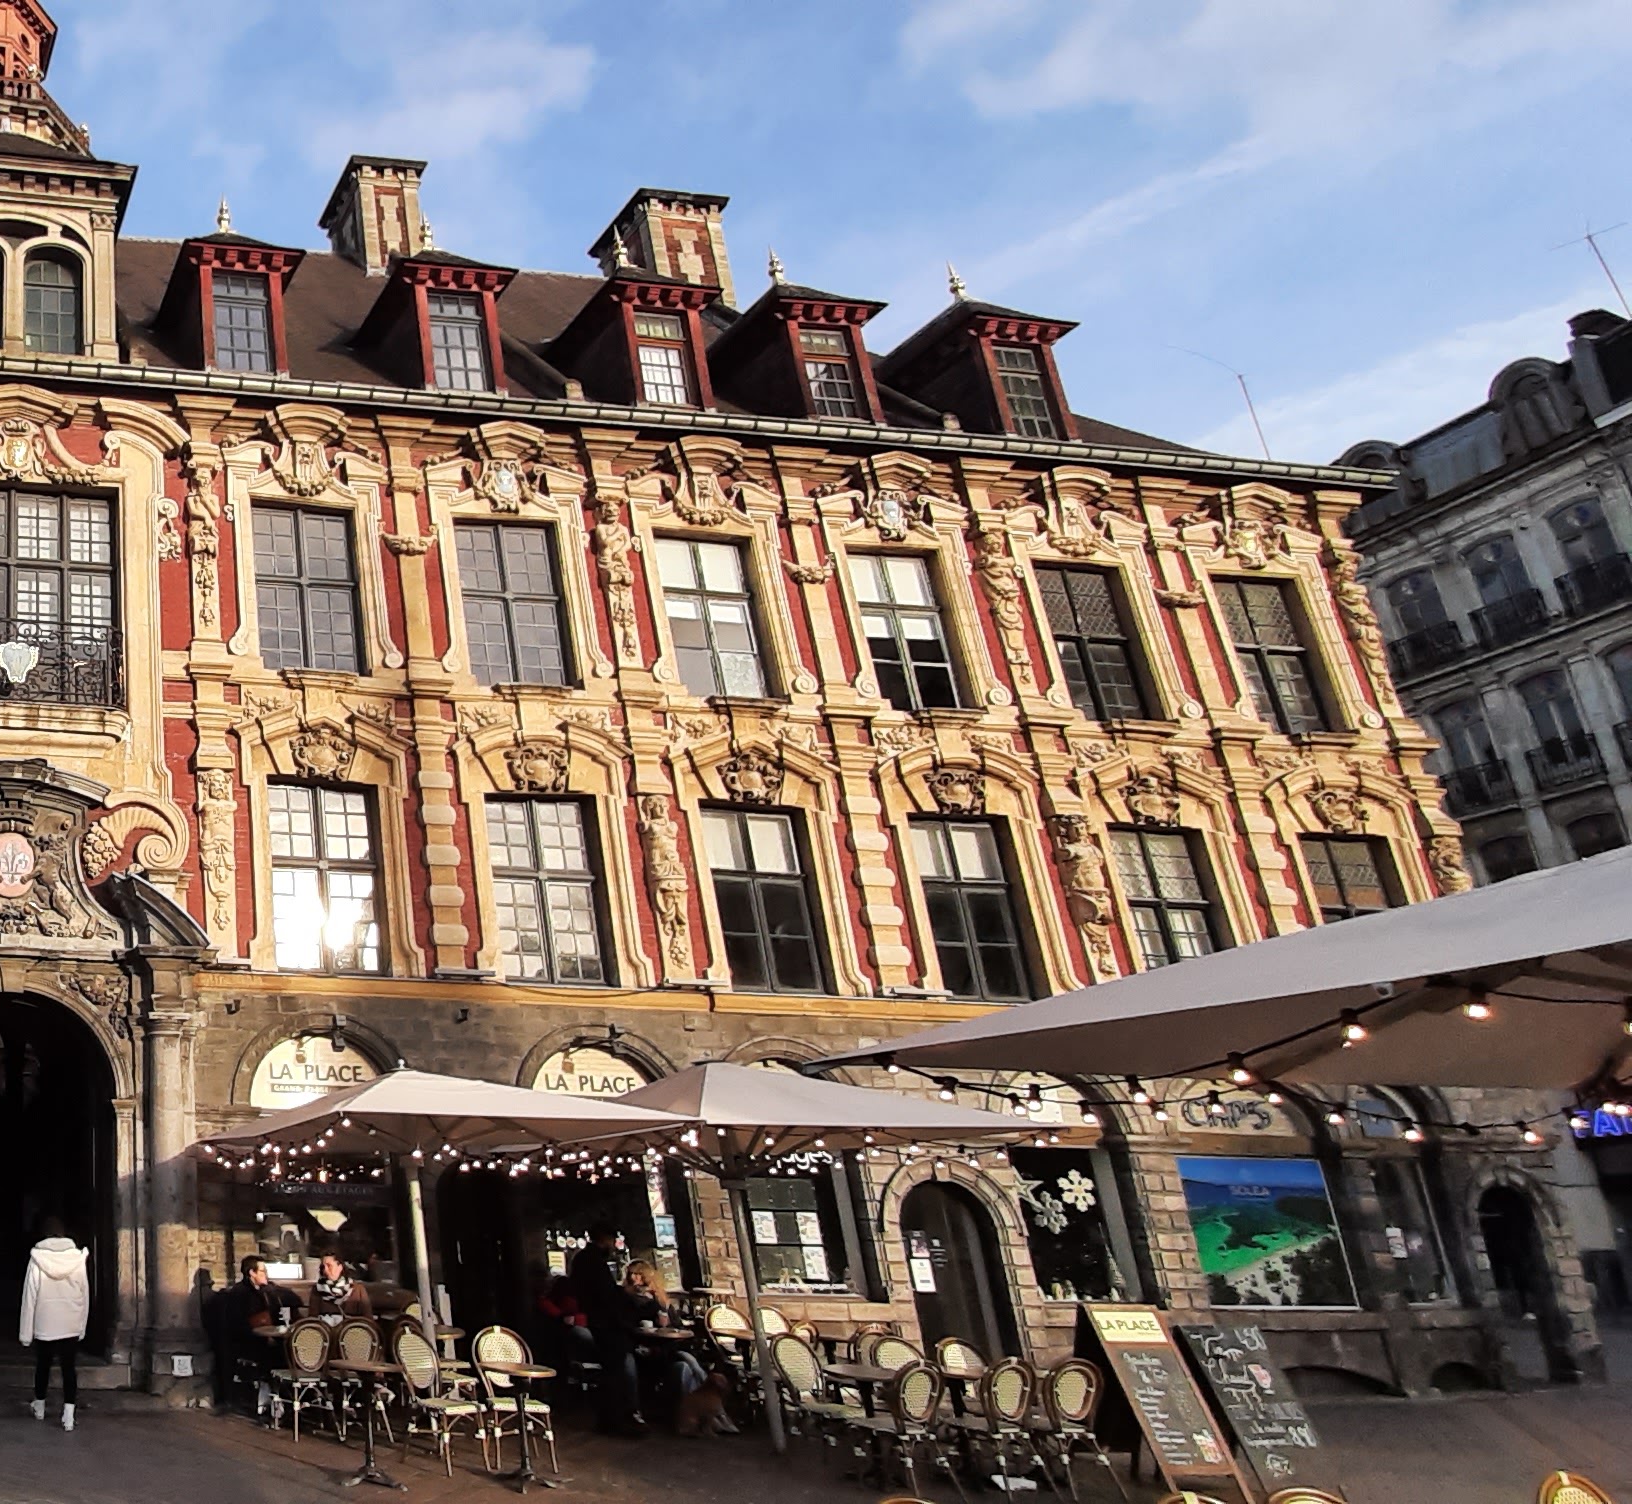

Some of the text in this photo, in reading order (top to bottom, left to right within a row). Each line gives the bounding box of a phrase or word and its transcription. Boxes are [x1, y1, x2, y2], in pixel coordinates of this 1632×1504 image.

[270, 1062, 366, 1083] LA PLACE
[544, 1073, 636, 1094] LA PLACE
[1118, 1319, 1160, 1332] PLACE
